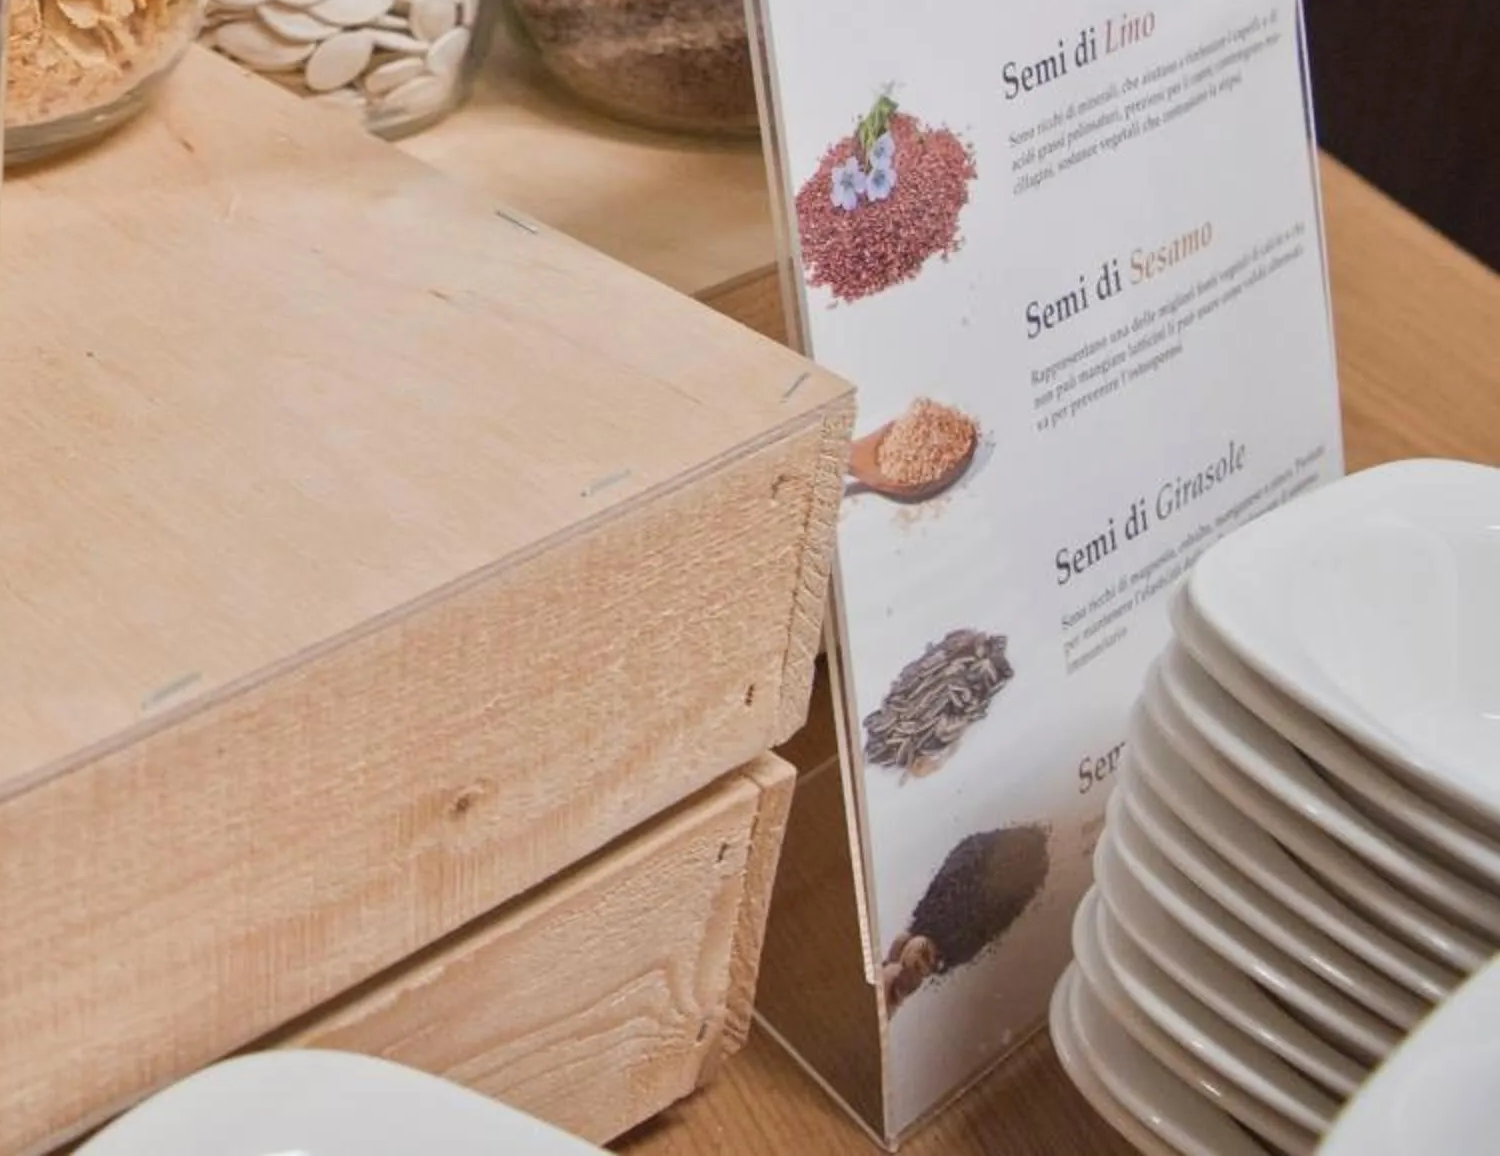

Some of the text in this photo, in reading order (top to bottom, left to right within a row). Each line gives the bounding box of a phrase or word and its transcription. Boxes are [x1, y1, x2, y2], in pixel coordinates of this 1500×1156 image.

[1002, 11, 1156, 100] Semi di Lino
[1025, 220, 1213, 340] Semi di Sesamo
[1055, 517, 1118, 586] Semi
[1124, 496, 1149, 542] di
[1155, 439, 1247, 521] Girasole
